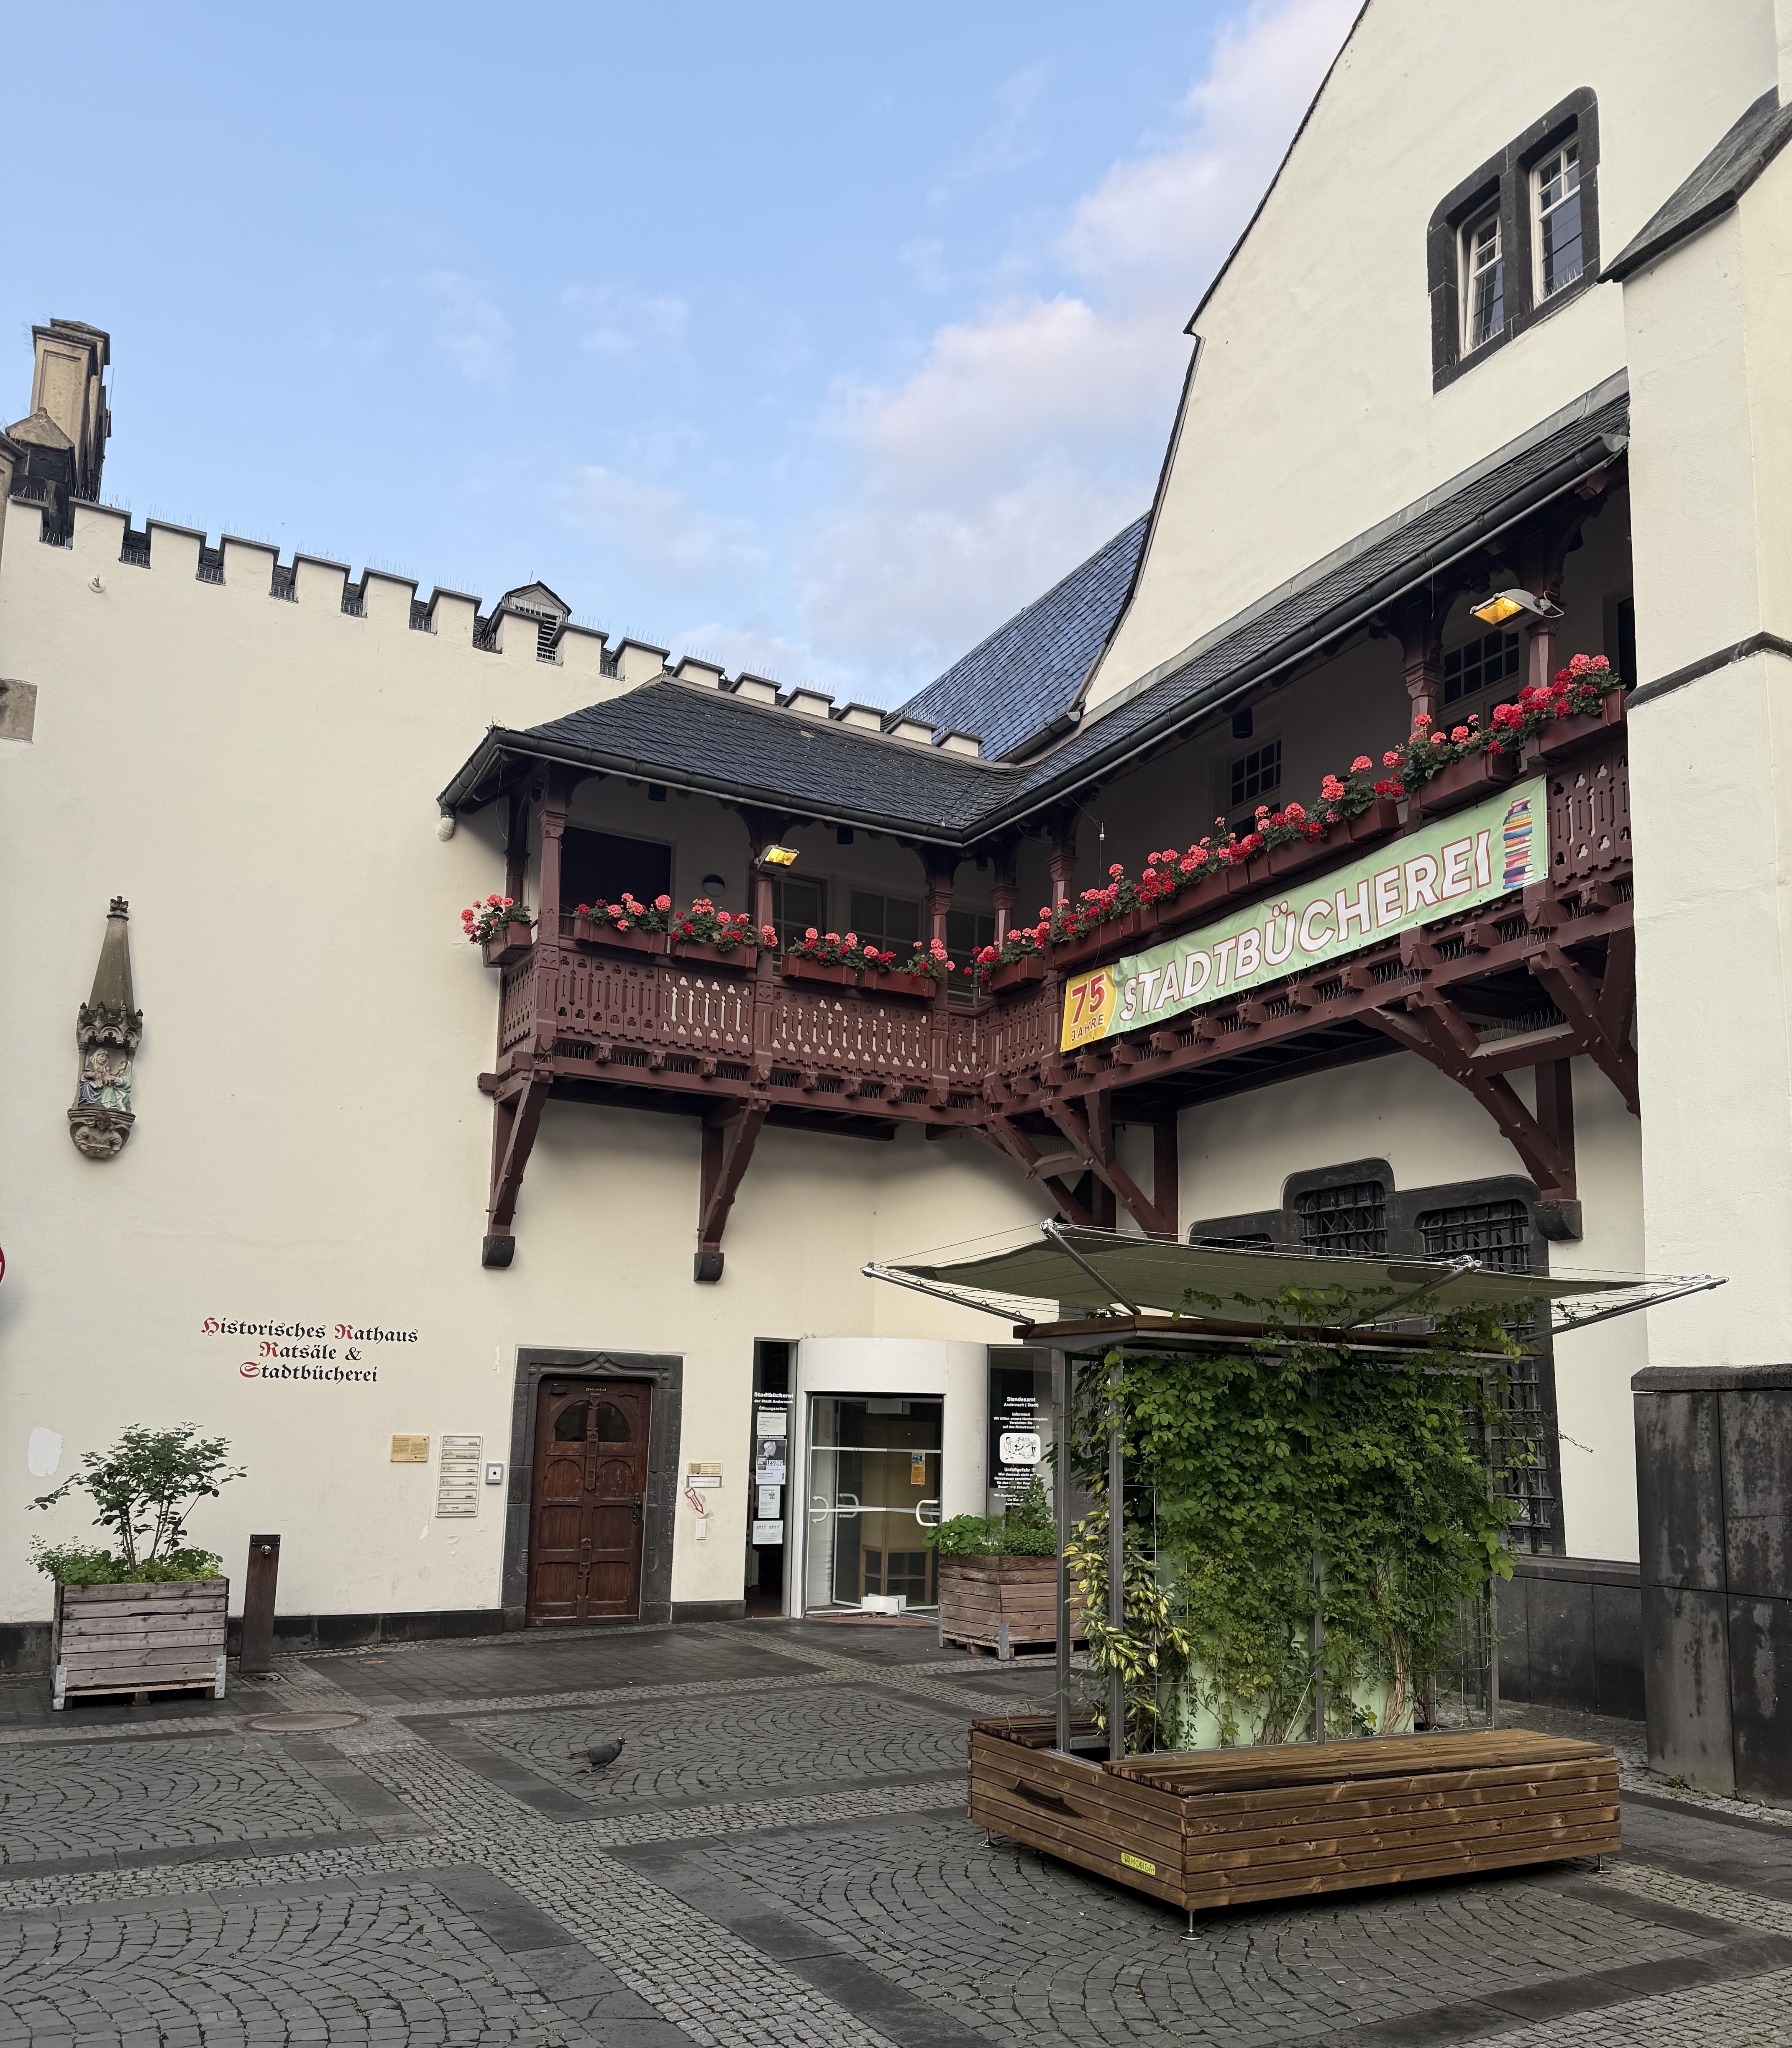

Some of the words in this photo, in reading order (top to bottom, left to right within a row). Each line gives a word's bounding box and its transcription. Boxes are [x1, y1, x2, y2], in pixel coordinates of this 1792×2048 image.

[1119, 828, 1492, 1022] STADTBÜCHEREI
[1071, 972, 1106, 1026] 75
[1071, 1014, 1105, 1042] JAHRE
[201, 1316, 326, 1341] Historisches
[334, 1324, 418, 1343] Rathaus
[259, 1341, 337, 1359] Ratsäle
[345, 1347, 363, 1361] &
[240, 1362, 378, 1384] Stadtbücherei
